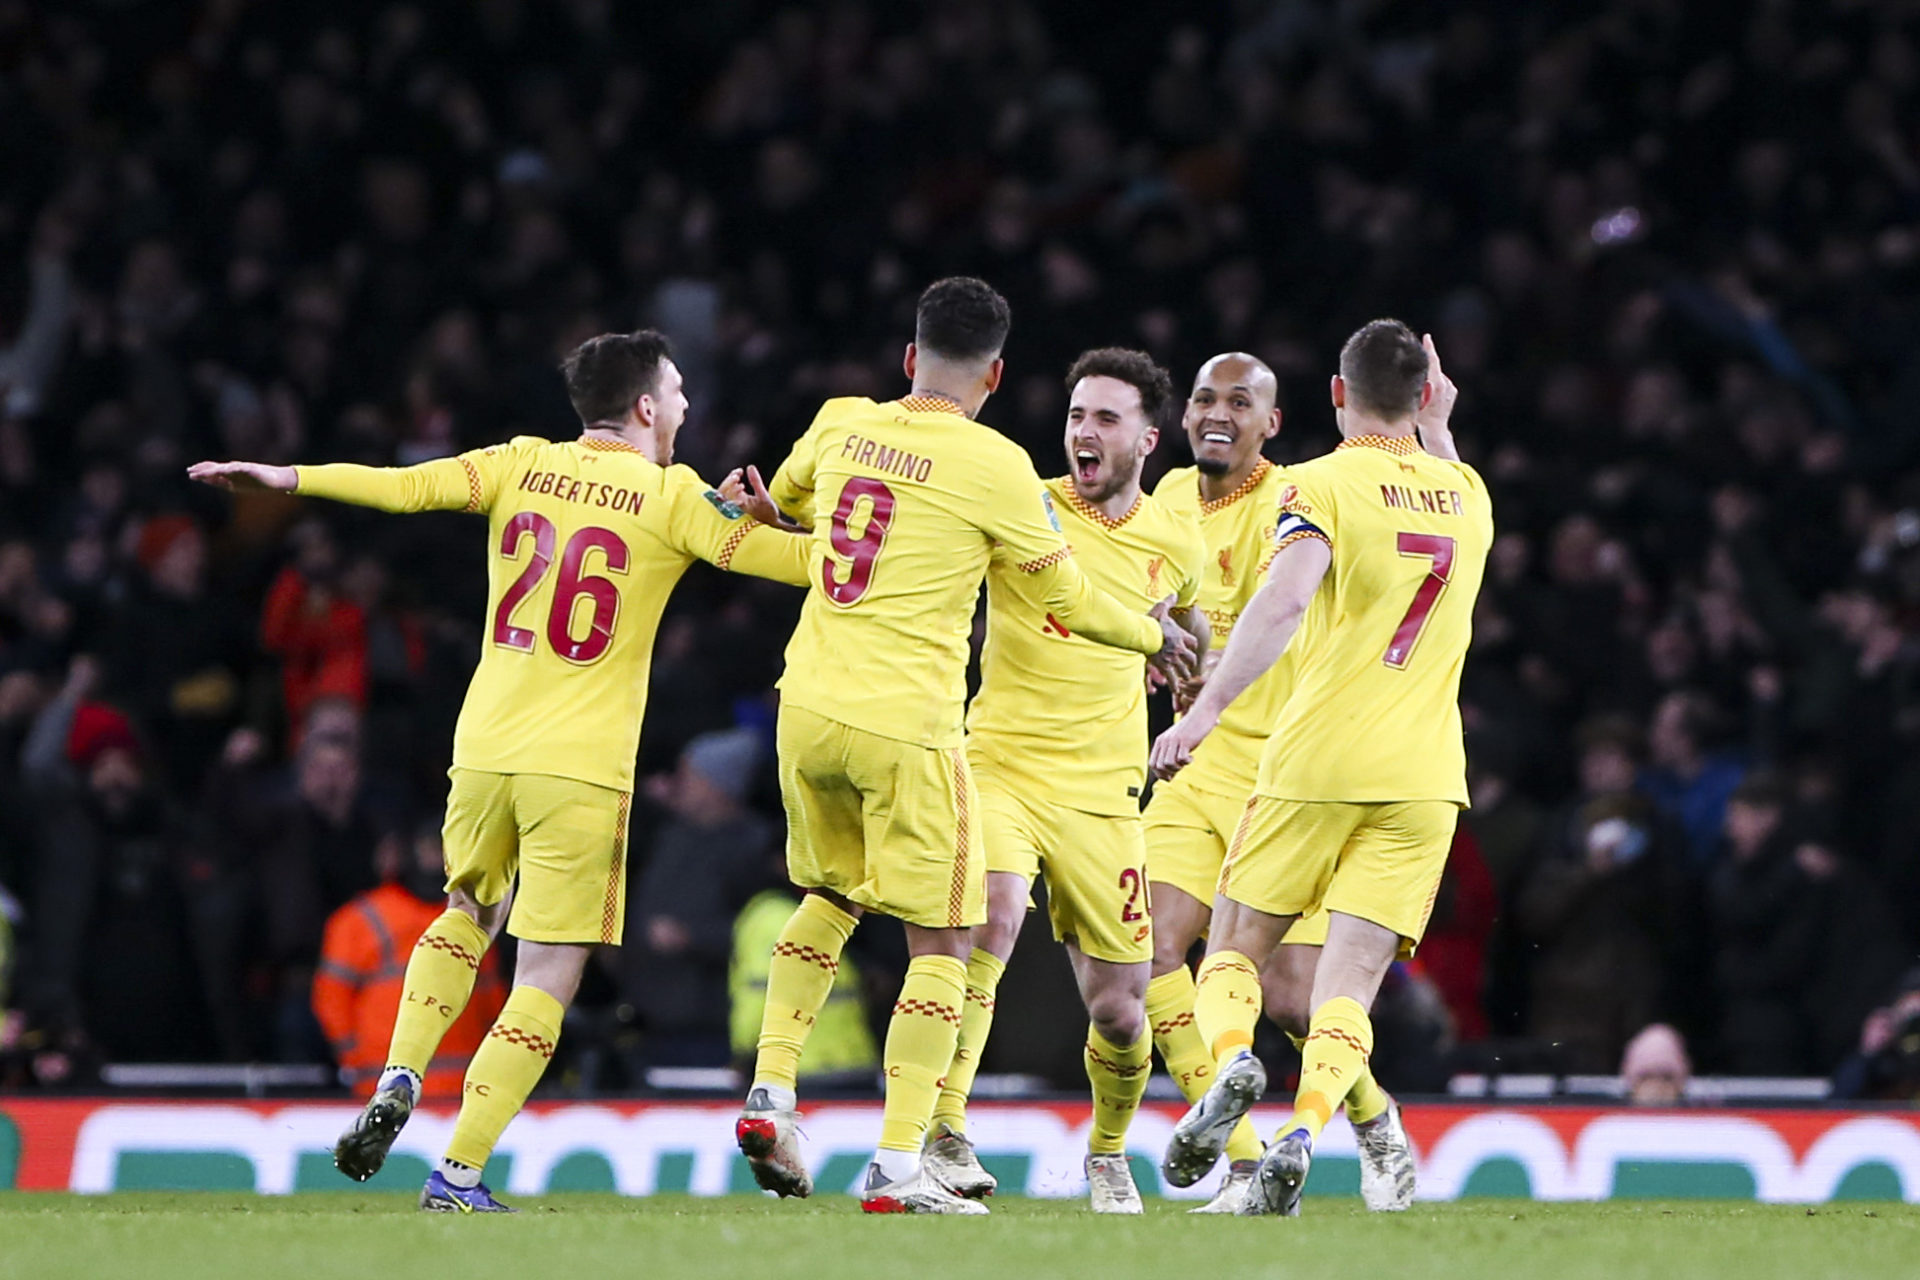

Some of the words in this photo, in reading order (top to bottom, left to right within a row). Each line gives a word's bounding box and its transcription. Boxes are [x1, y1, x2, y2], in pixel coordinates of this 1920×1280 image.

[841, 434, 932, 483] FIRMINO
[1380, 484, 1464, 516] MILNER
[493, 511, 631, 667] 26
[822, 476, 896, 609] 9
[1383, 532, 1457, 671] 7
